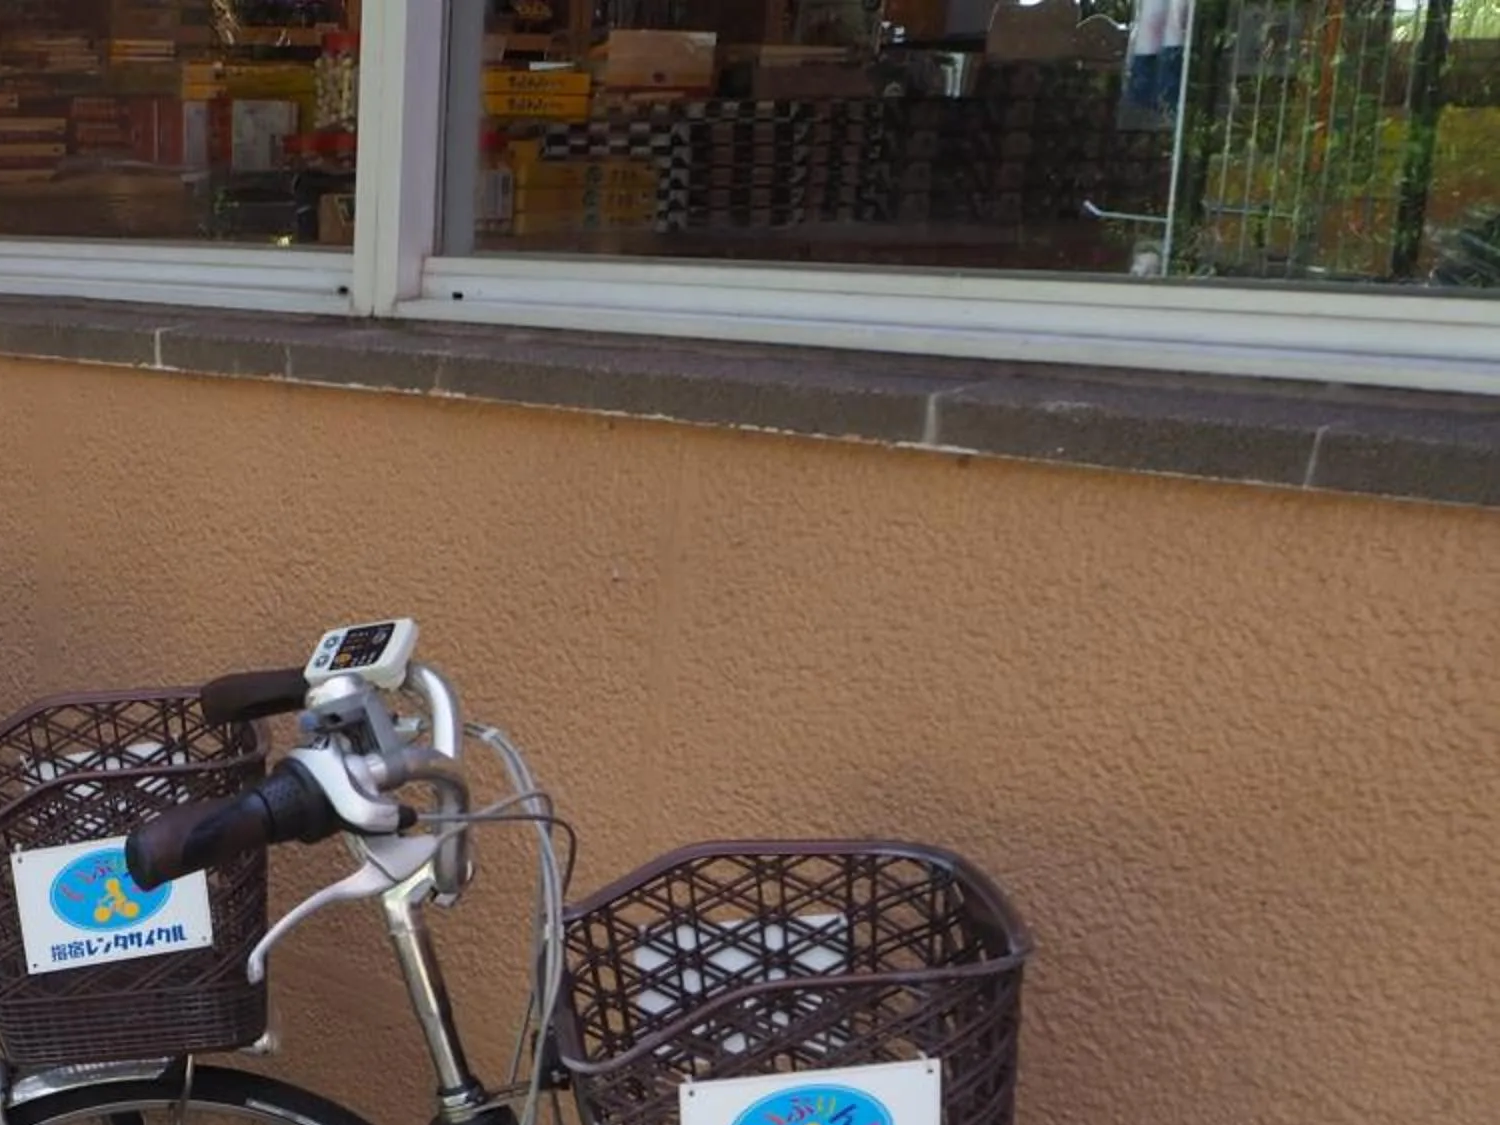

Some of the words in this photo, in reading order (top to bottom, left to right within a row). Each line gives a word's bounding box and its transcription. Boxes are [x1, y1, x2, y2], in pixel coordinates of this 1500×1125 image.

[51, 924, 188, 962] 指宿レンタサイクル
